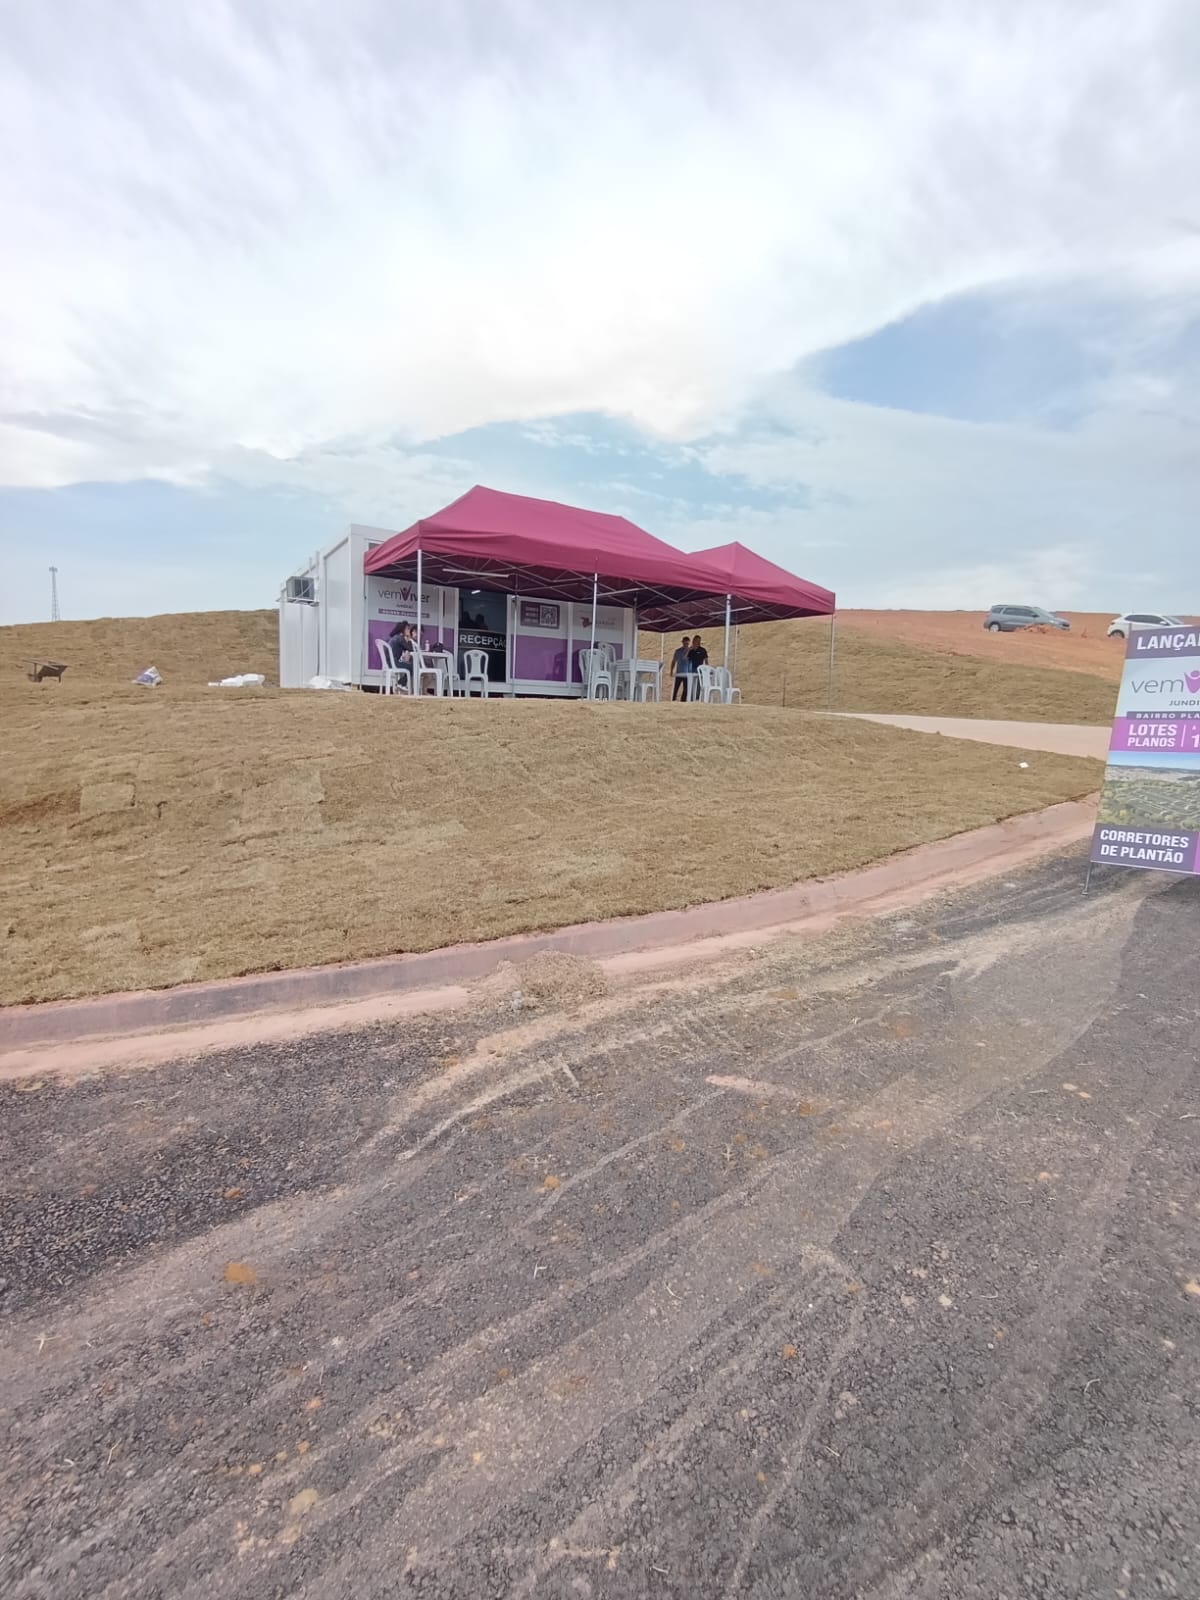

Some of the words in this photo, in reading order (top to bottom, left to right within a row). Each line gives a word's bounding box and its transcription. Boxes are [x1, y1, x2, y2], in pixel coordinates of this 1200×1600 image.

[1137, 633, 1200, 650] LANÇA
[1128, 724, 1178, 736] LOTES
[1127, 737, 1176, 748] PLANOS
[1100, 829, 1190, 848] CORRETORES
[1100, 844, 1119, 857] DE
[1120, 846, 1184, 864] PLANTÃO
